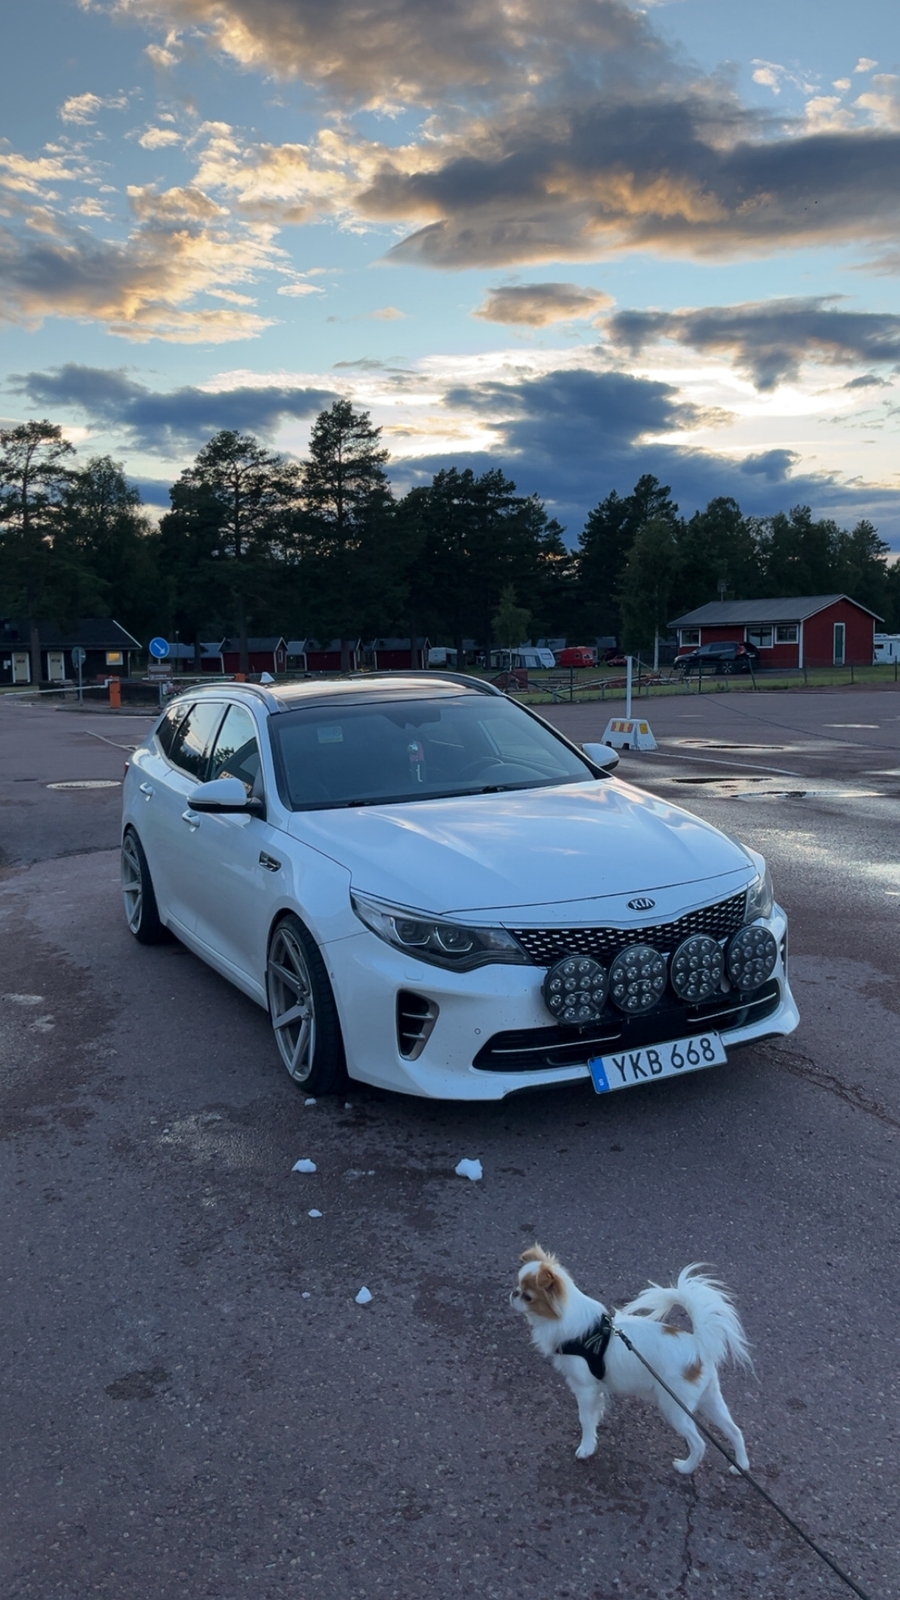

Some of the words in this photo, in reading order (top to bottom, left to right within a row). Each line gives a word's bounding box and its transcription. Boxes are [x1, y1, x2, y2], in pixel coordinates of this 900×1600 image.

[631, 898, 654, 909] KIA
[612, 1050, 663, 1082] YKB
[670, 1037, 715, 1068] 668
[598, 1078, 604, 1086] S
